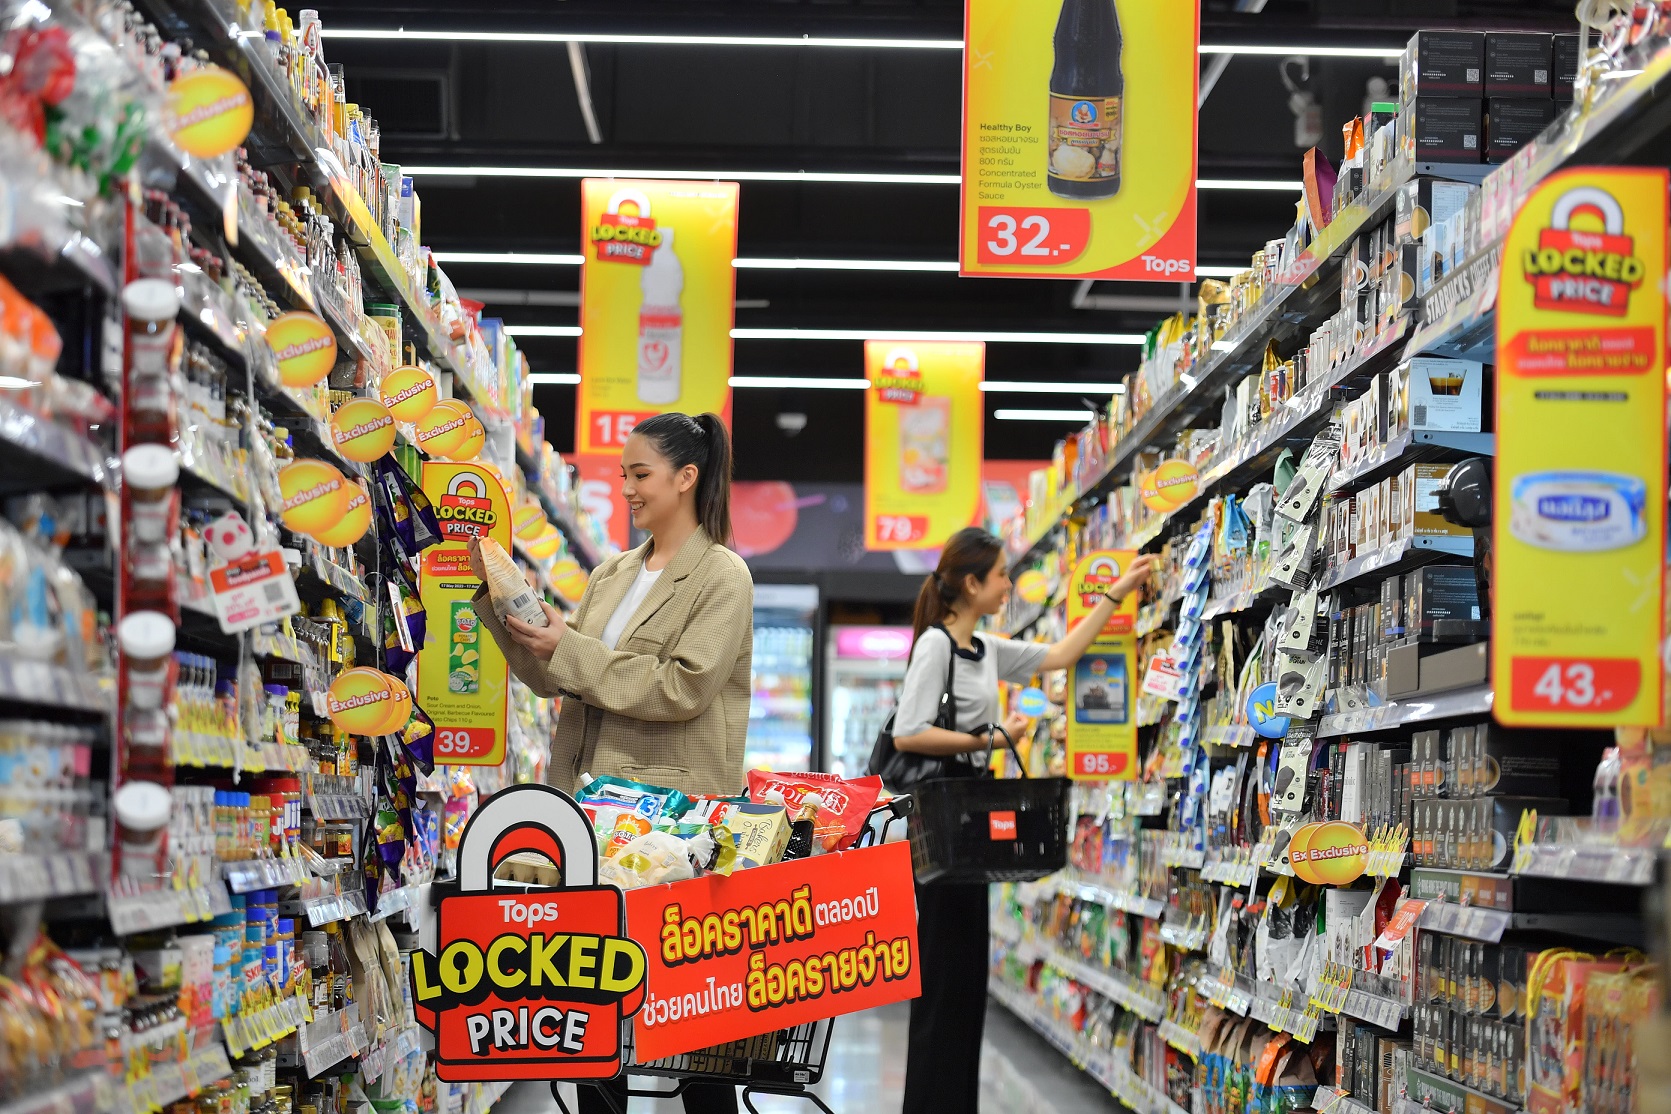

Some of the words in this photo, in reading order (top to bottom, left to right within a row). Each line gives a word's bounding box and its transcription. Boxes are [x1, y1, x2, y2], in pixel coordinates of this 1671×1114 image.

[980, 123, 1013, 132] Healthy
[1015, 124, 1032, 133] Boy
[979, 157, 995, 165] 800
[979, 168, 1037, 177] Concentrated
[978, 191, 1005, 199] Sauce
[979, 180, 1012, 188] Formula
[1014, 181, 1042, 190] Oyster
[592, 224, 663, 248] LOCKED
[987, 214, 1071, 257] 32.-
[606, 244, 645, 259] PRICE
[1141, 255, 1191, 276] Tops
[1523, 248, 1645, 283] LOCKED
[1426, 269, 1471, 325] STARBUCKS
[1550, 279, 1616, 306] PRICE
[275, 334, 333, 361] xclusive
[384, 379, 433, 408] Exclusive
[335, 415, 394, 444] Exclusive
[419, 418, 466, 442] Exclusive
[1157, 474, 1198, 489] Exclusive
[458, 497, 475, 506] Tops
[433, 505, 497, 524] LOCKED
[447, 523, 481, 536] PRICE
[330, 690, 390, 713] Exclusive
[438, 731, 479, 753] 39.-
[992, 820, 1015, 831] Tops
[1310, 845, 1368, 861] Exclusive
[499, 899, 558, 928] Tops
[660, 885, 815, 966] ล็อคราคาดี
[815, 886, 879, 926] ตลอดปี
[412, 935, 645, 1001] LOCKED
[643, 976, 743, 1026] ช่วยคนไทย
[745, 932, 912, 1012] ล็อครายจ่าย
[466, 1007, 589, 1053] PRICE
